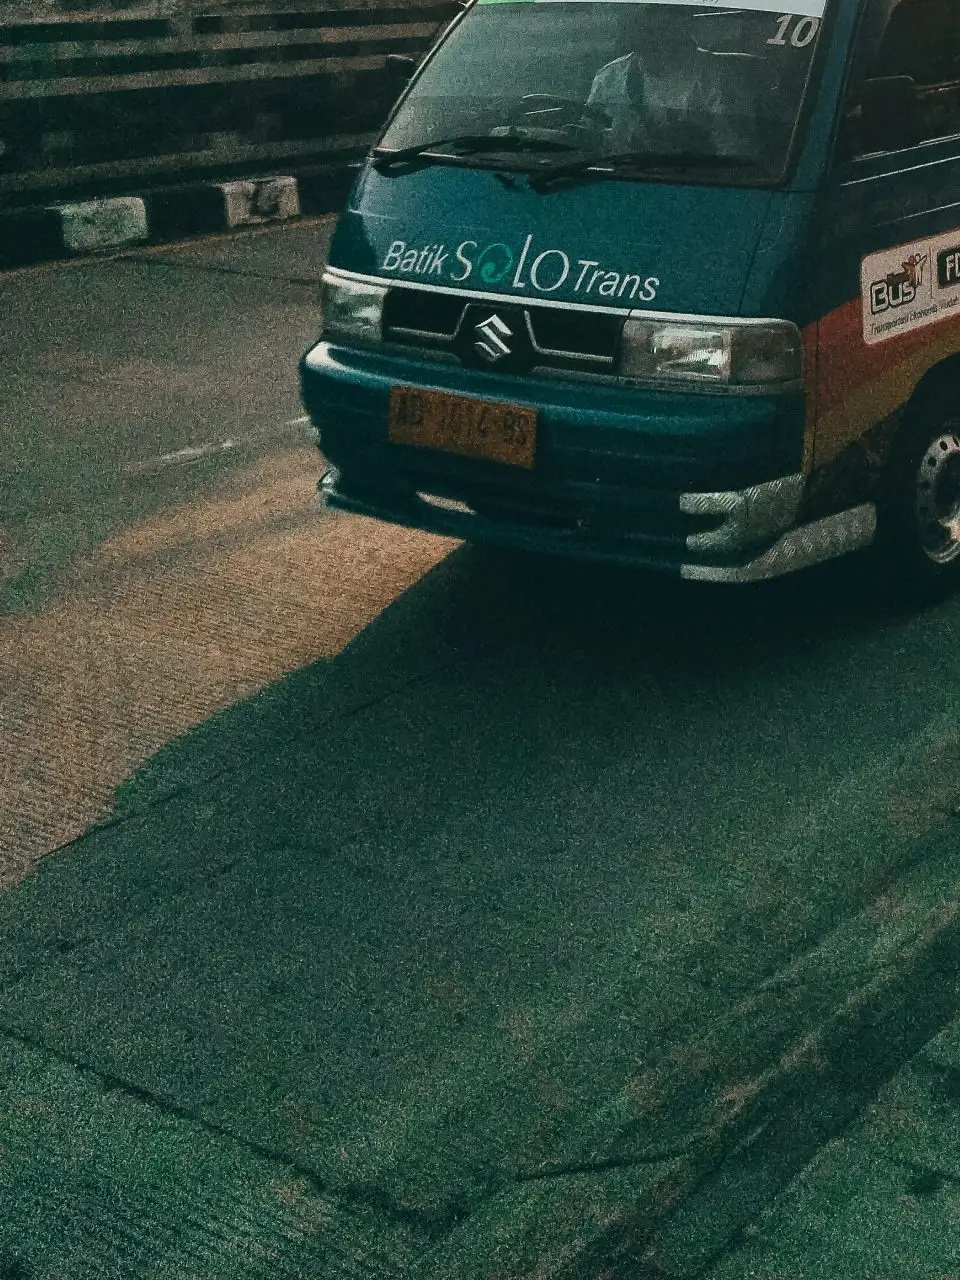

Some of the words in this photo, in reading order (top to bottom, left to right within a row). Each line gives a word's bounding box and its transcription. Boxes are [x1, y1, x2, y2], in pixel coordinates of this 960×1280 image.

[766, 14, 820, 48] 10
[381, 240, 450, 276] Batik
[572, 258, 661, 303] Trans
